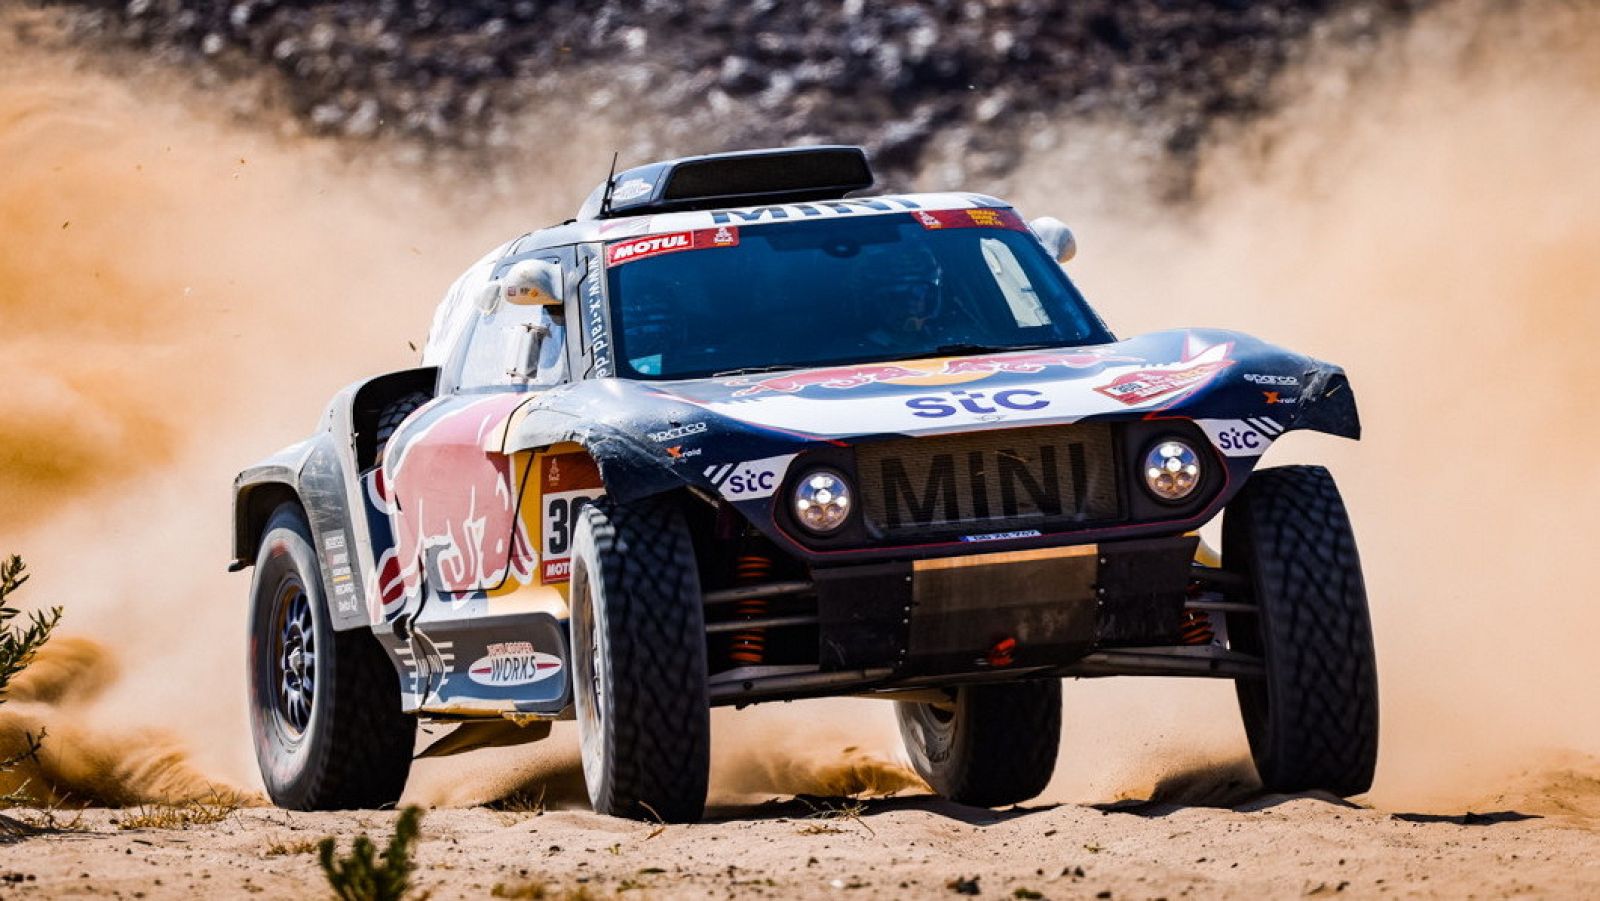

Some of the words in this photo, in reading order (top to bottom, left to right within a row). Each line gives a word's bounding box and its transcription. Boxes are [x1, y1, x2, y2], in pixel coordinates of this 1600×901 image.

[614, 235, 688, 259] MOTUL
[905, 390, 1050, 418] stc
[1219, 427, 1259, 449] stc
[729, 469, 775, 493] stc
[881, 443, 1088, 529] MINI
[491, 655, 536, 681] WORKS
